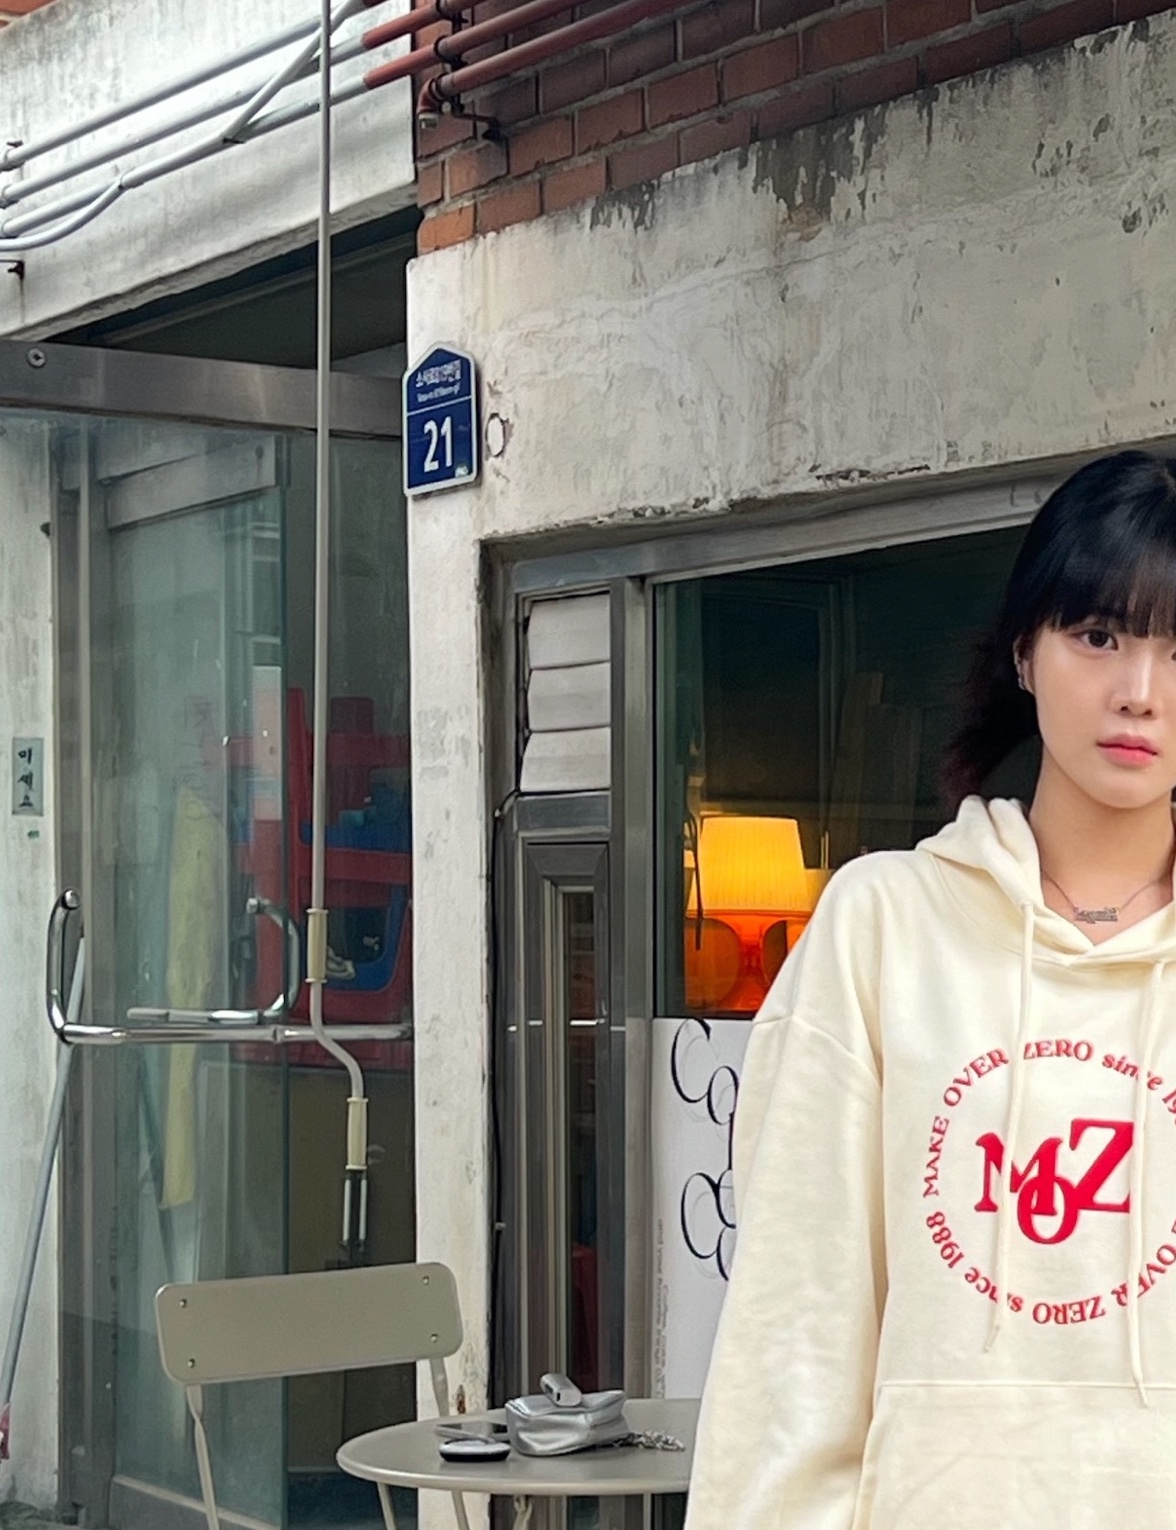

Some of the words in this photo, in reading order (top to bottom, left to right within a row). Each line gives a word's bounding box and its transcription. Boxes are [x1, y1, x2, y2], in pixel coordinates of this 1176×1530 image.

[423, 416, 452, 472] 21
[943, 1048, 1009, 1107] OVER
[1023, 1039, 1094, 1061] ZERO
[1102, 1054, 1163, 1091] sine
[923, 1115, 950, 1198] MAKE
[926, 1211, 964, 1269] 1988
[1032, 1296, 1106, 1325] ZERO
